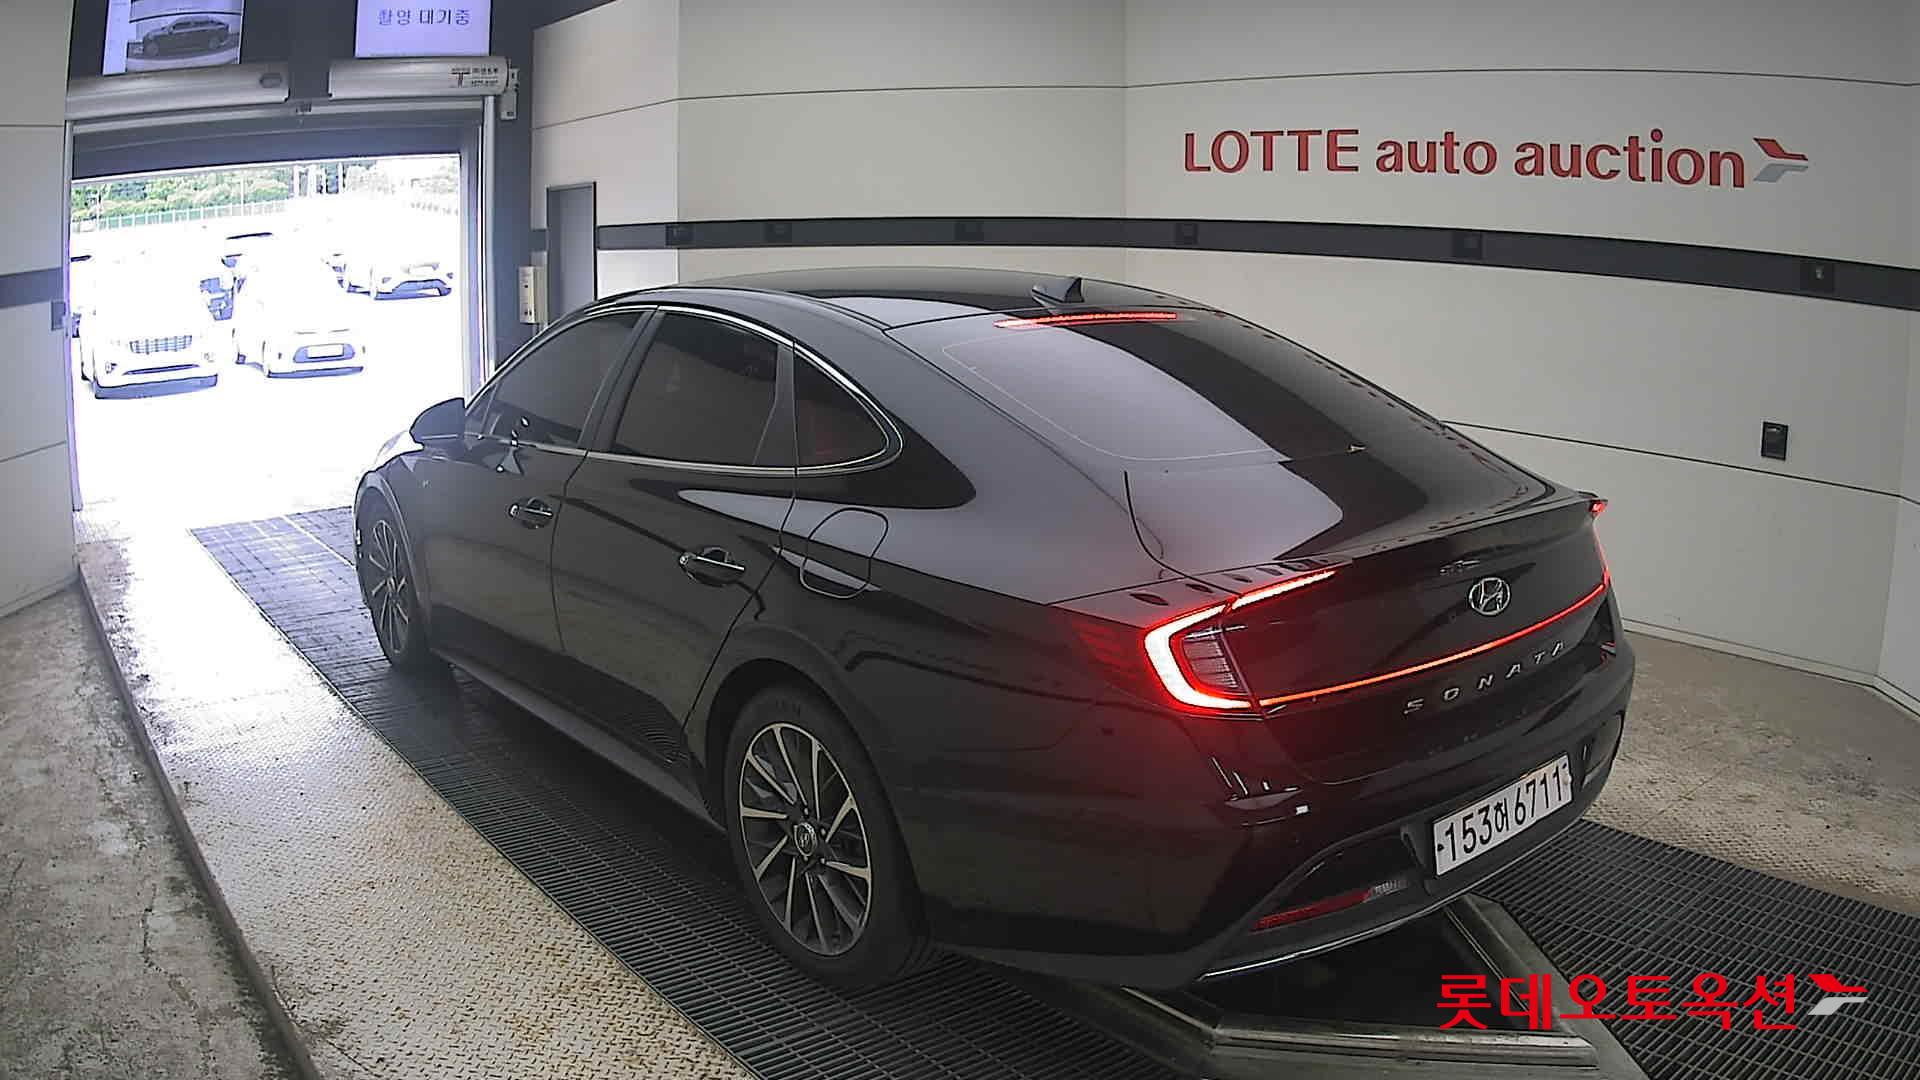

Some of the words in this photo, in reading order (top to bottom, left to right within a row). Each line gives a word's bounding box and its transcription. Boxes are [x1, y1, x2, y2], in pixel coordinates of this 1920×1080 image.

[419, 8, 471, 26] 대기중
[1184, 129, 1360, 173] LOTTE
[1376, 131, 1498, 175] auto
[1514, 129, 1745, 188] auction
[1403, 641, 1564, 715] SONATA
